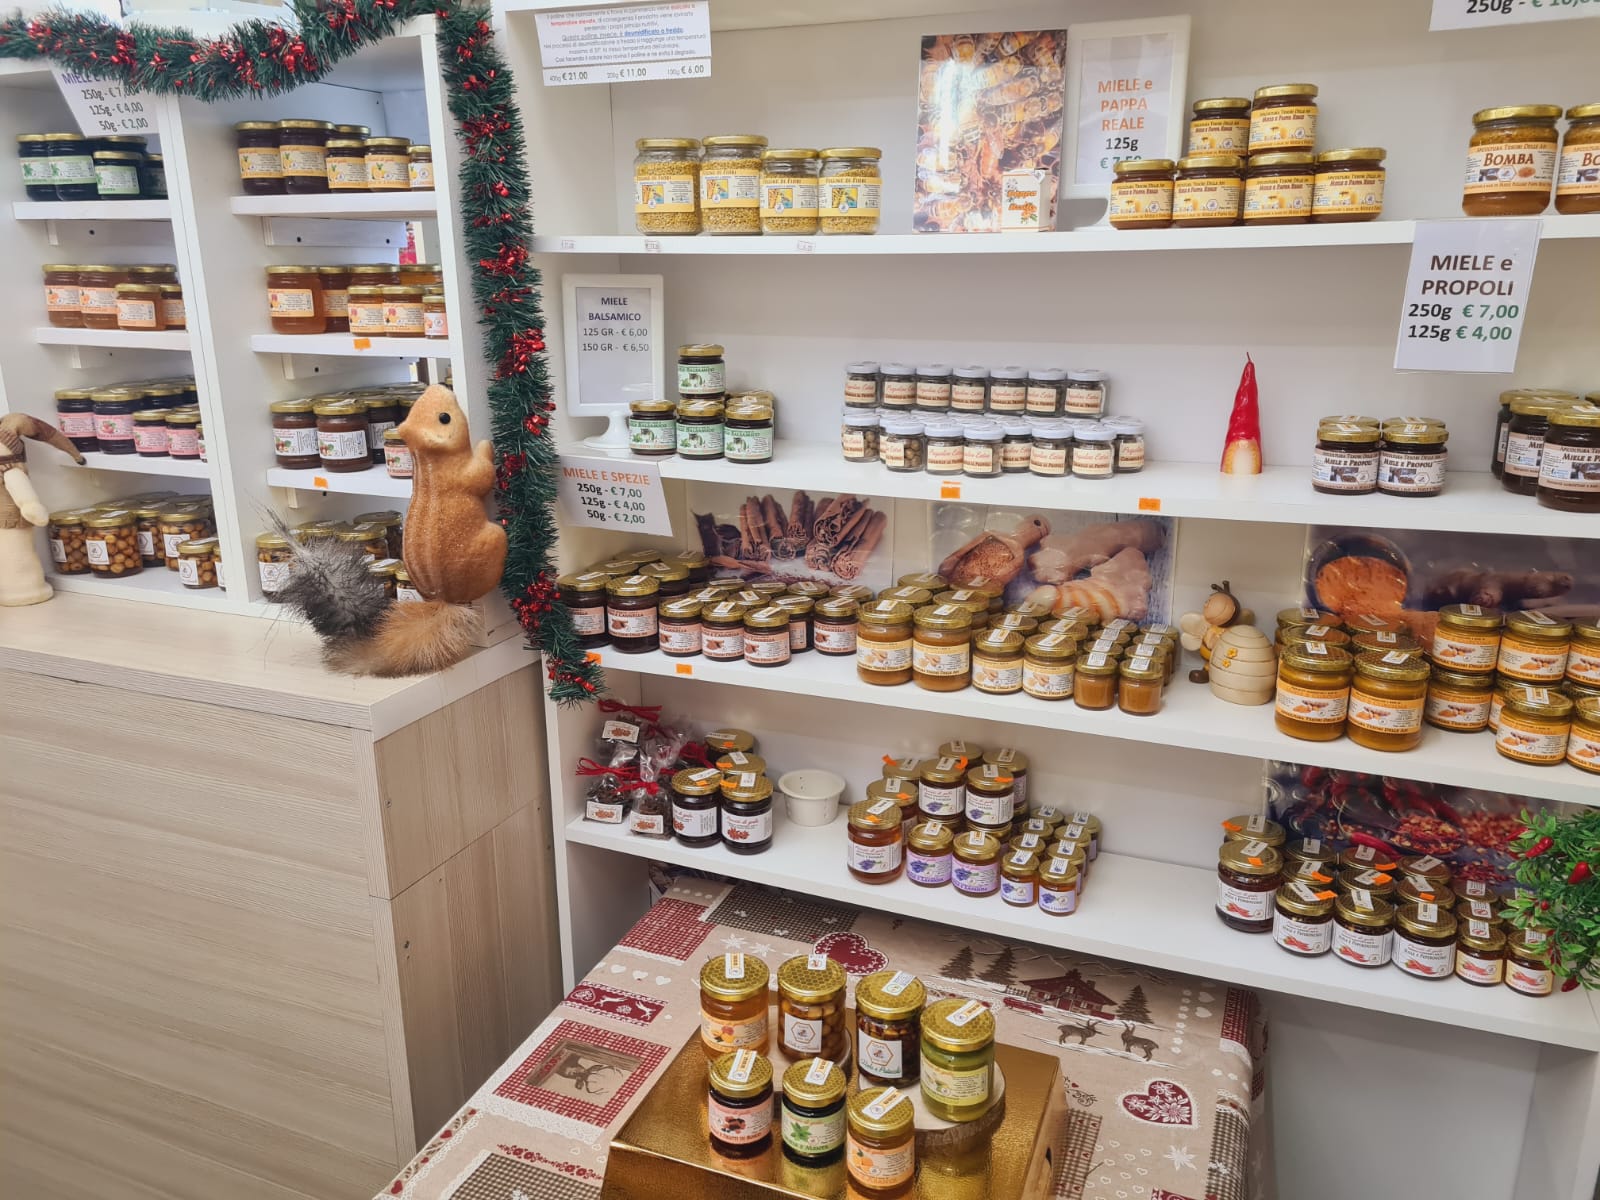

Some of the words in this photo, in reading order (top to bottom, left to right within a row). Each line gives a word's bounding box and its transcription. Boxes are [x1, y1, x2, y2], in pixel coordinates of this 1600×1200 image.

[1098, 78, 1140, 93] MIELE
[1144, 80, 1153, 90] e
[81, 88, 104, 101] 250g
[89, 104, 112, 117] 125g
[124, 102, 144, 114] 4,00
[1101, 97, 1148, 112] PAPPA
[98, 120, 118, 132] 50g
[130, 117, 149, 130] 2,00
[1102, 117, 1145, 131] REALE
[1105, 136, 1139, 152] 125g
[1483, 152, 1534, 166] BOMBA
[1430, 254, 1495, 271] MIELE
[1500, 257, 1513, 271] e
[1421, 280, 1514, 296] PROPOLI
[601, 297, 628, 306] MIELE
[588, 312, 642, 321] BALSAMICO
[1408, 304, 1452, 320] 250g
[1462, 304, 1474, 318] €
[1479, 304, 1520, 320] 7,00
[583, 328, 598, 336] 125
[601, 328, 614, 336] GR
[621, 328, 627, 336] €
[629, 328, 648, 338] 6,00
[1408, 324, 1452, 342] 125g
[1456, 325, 1468, 339] €
[1472, 326, 1512, 342] 4,00
[582, 343, 598, 352] 150
[600, 344, 613, 352] GR
[622, 344, 628, 352] €
[630, 344, 649, 352] 6,50
[563, 466, 598, 480] MIELE
[601, 471, 608, 480] E
[610, 472, 650, 486] SPEZIE
[576, 482, 602, 496] 250g
[610, 486, 618, 496] €
[620, 488, 642, 498] 7,00
[580, 496, 606, 508] 125g
[614, 500, 621, 508] €
[623, 501, 646, 512] 4,00
[587, 510, 606, 522] 50g
[614, 513, 621, 522] €
[623, 514, 646, 524] 2,00
